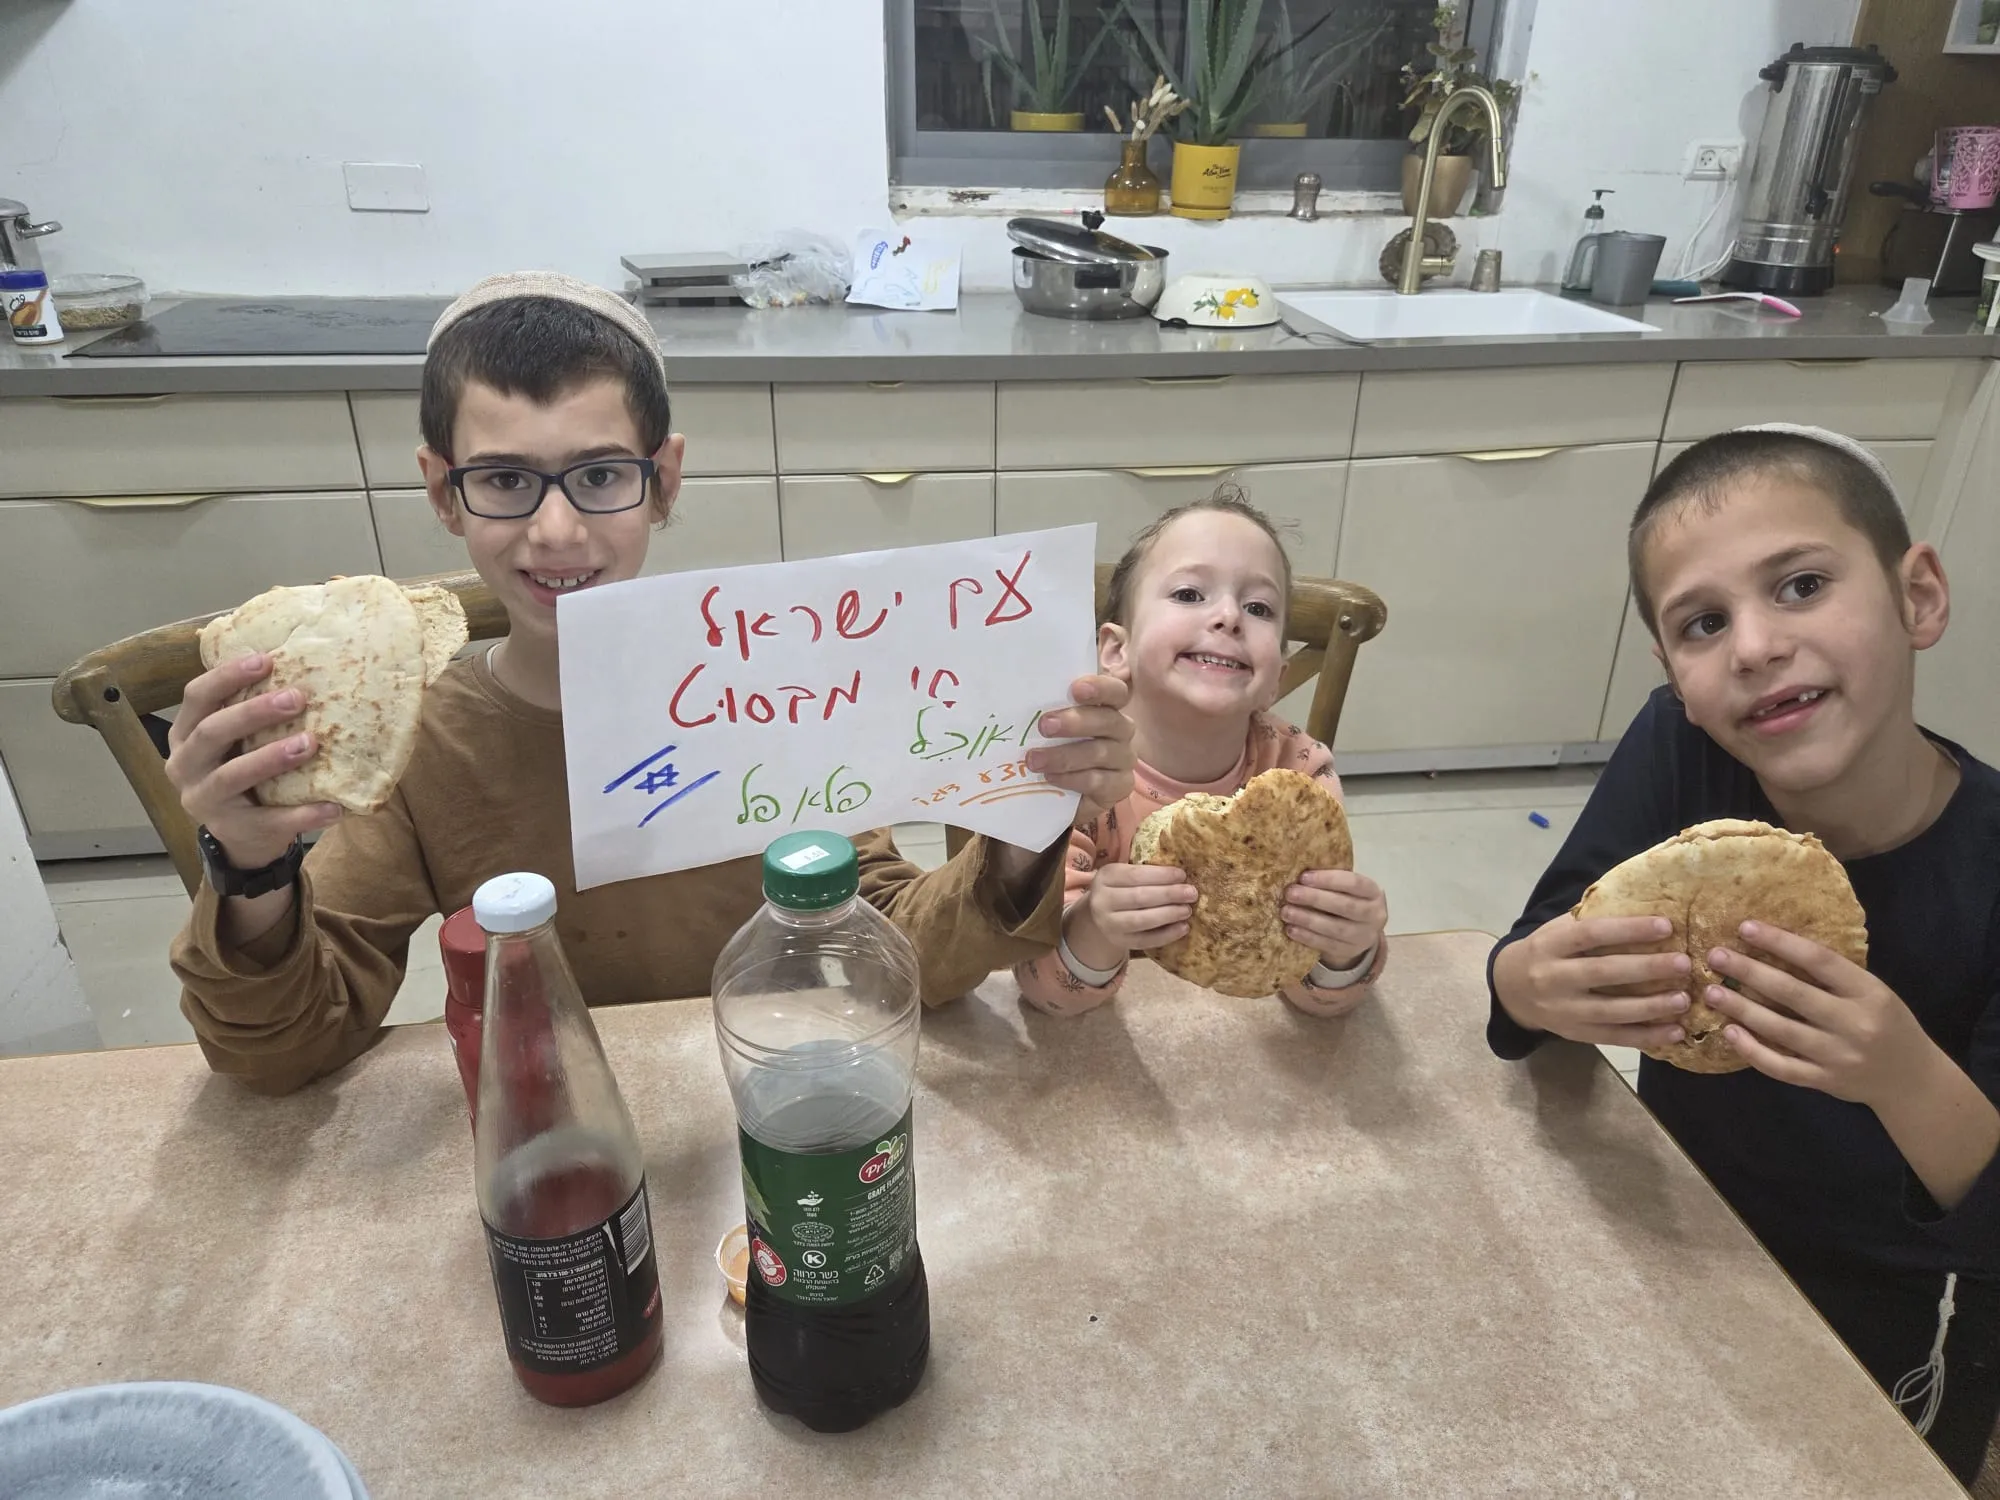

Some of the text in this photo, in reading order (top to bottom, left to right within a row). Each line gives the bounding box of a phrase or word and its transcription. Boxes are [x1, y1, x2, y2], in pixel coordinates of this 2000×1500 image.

[701, 551, 1032, 661] עם ישראל
[911, 666, 961, 709] חי
[866, 1143, 904, 1178] Prigat
[867, 1183, 887, 1200] GRAPE
[793, 1269, 839, 1280] כשר פרווה
